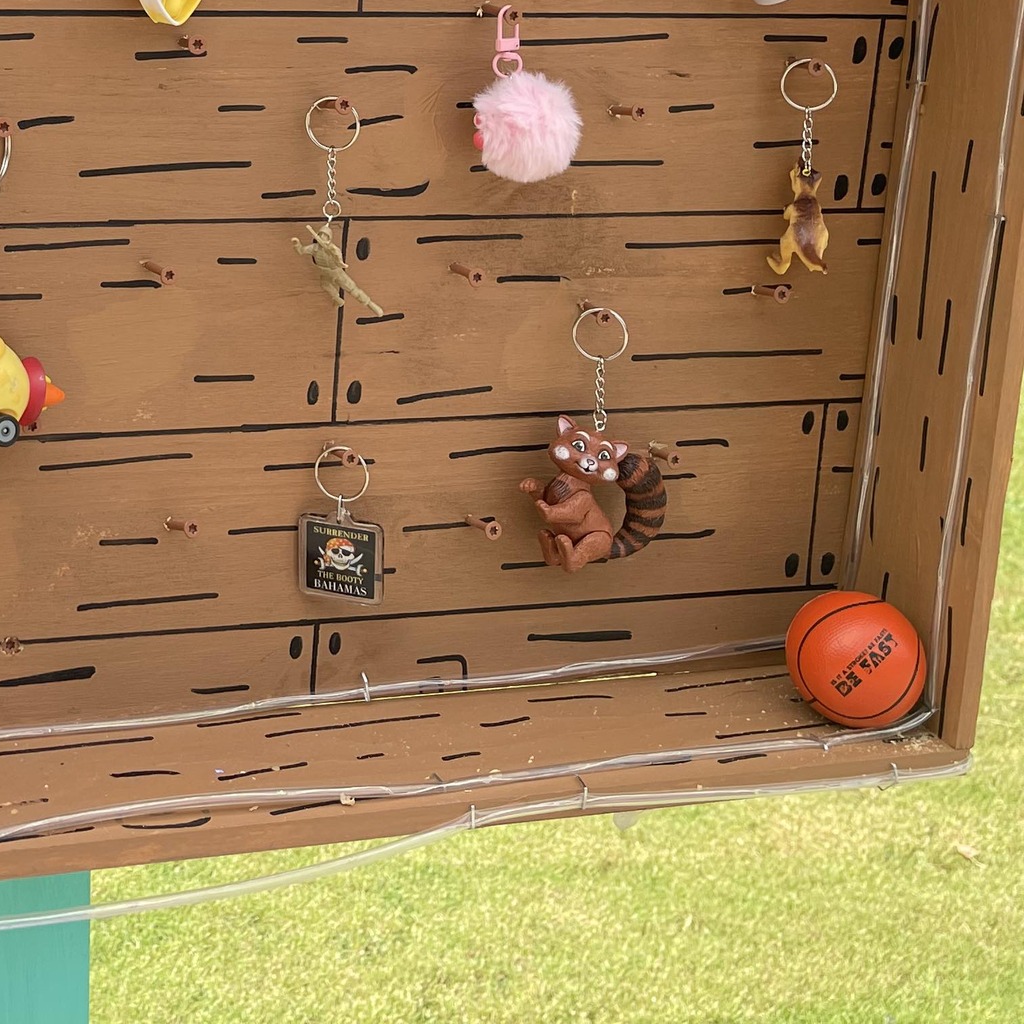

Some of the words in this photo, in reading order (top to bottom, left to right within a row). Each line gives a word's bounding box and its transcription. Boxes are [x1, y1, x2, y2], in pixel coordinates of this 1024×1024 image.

[313, 525, 369, 542] SURRENDER
[317, 569, 335, 580] THE
[336, 572, 364, 585] BOOTY
[314, 578, 367, 596] BAHAMAS
[835, 670, 863, 697] BE
[858, 632, 898, 675] FAST
